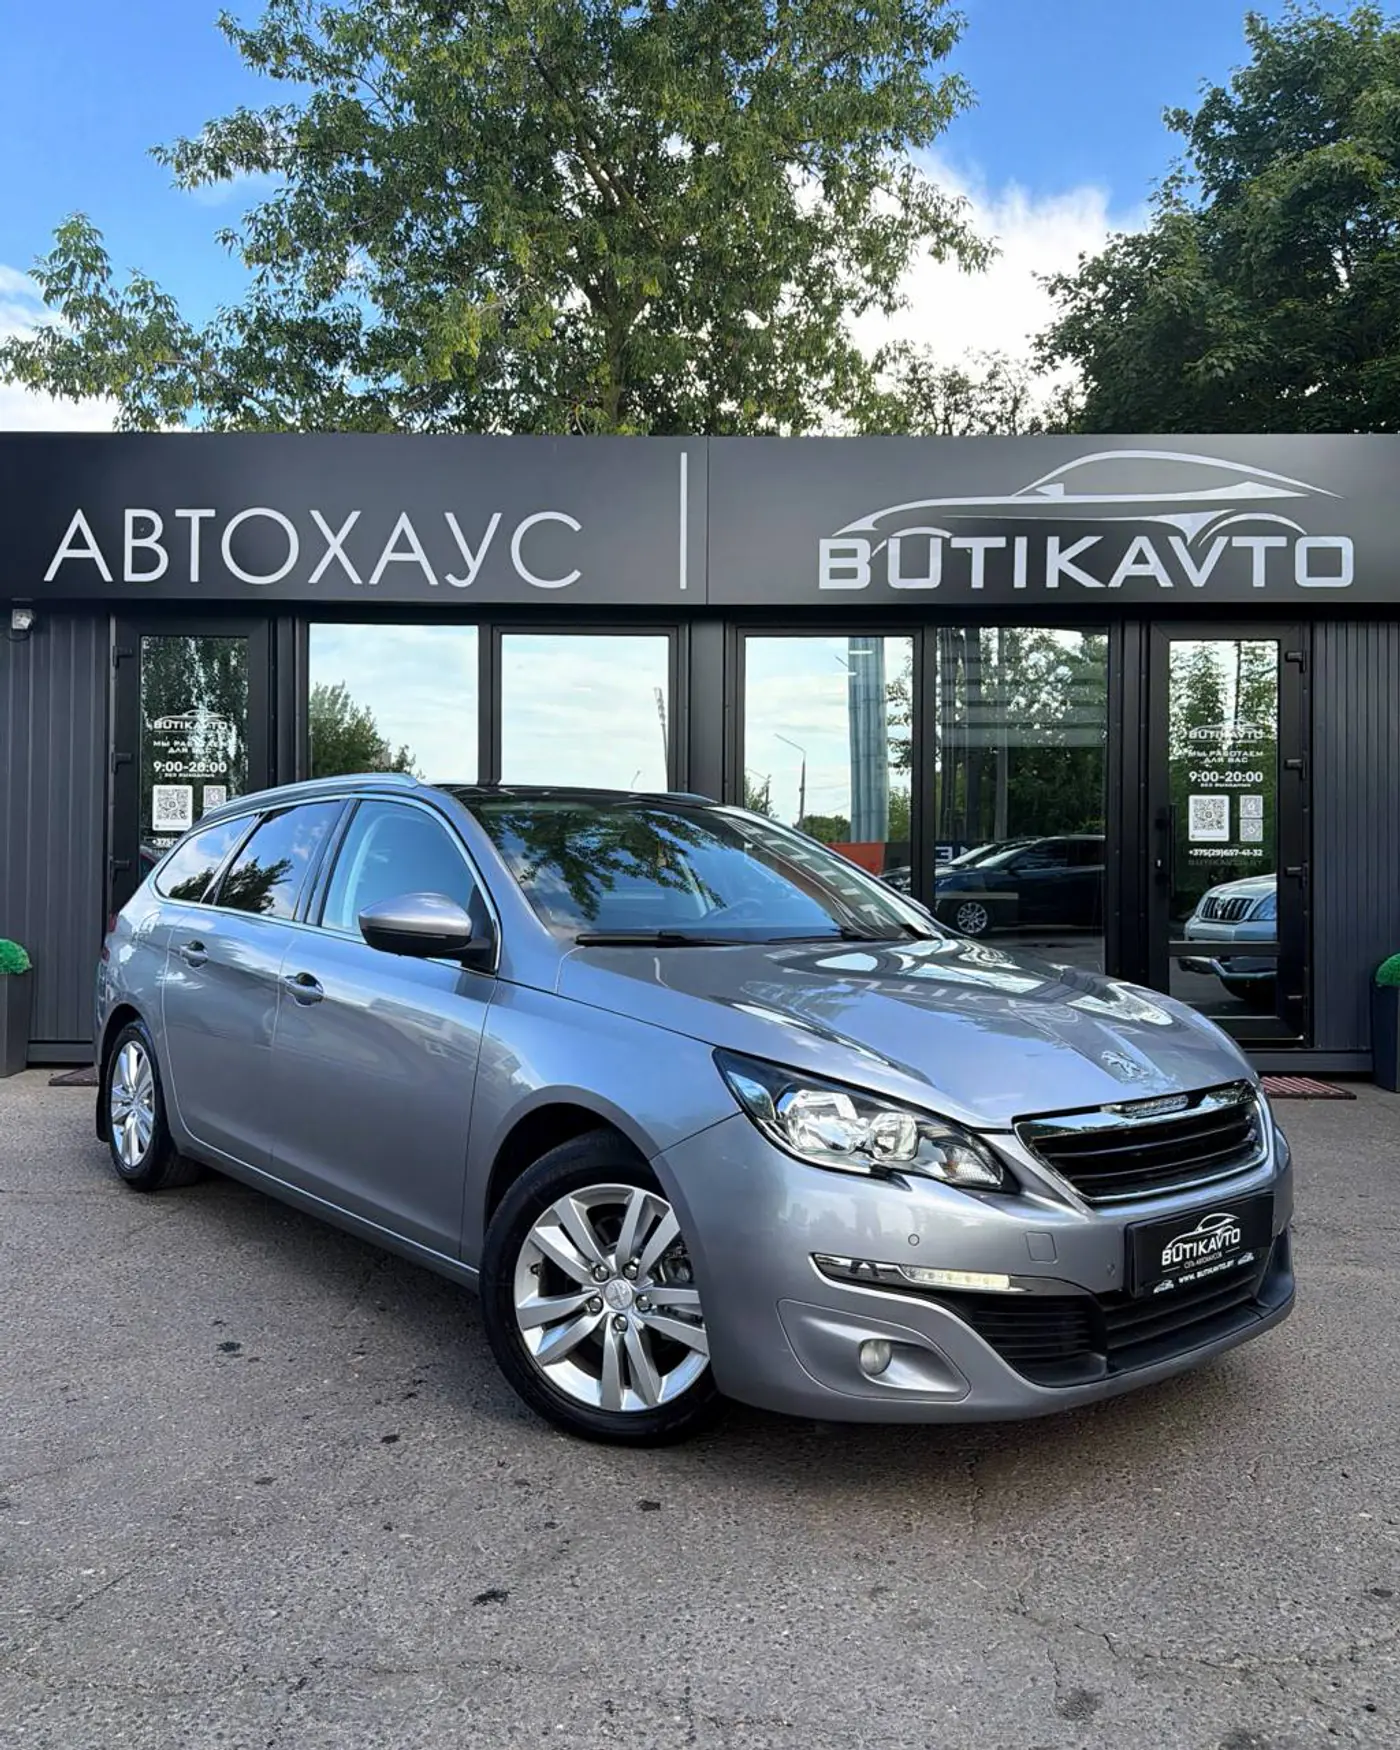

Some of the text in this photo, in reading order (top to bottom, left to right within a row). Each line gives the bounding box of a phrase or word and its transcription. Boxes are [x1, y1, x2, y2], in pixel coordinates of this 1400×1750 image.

[43, 507, 582, 588] АВТОХАУС
[818, 535, 1355, 590] BUTIKAVTO
[153, 761, 227, 773] 9:00-20:00
[1188, 771, 1264, 782] 9:00-20:00
[1161, 1227, 1241, 1267] BUTIKAVTO
